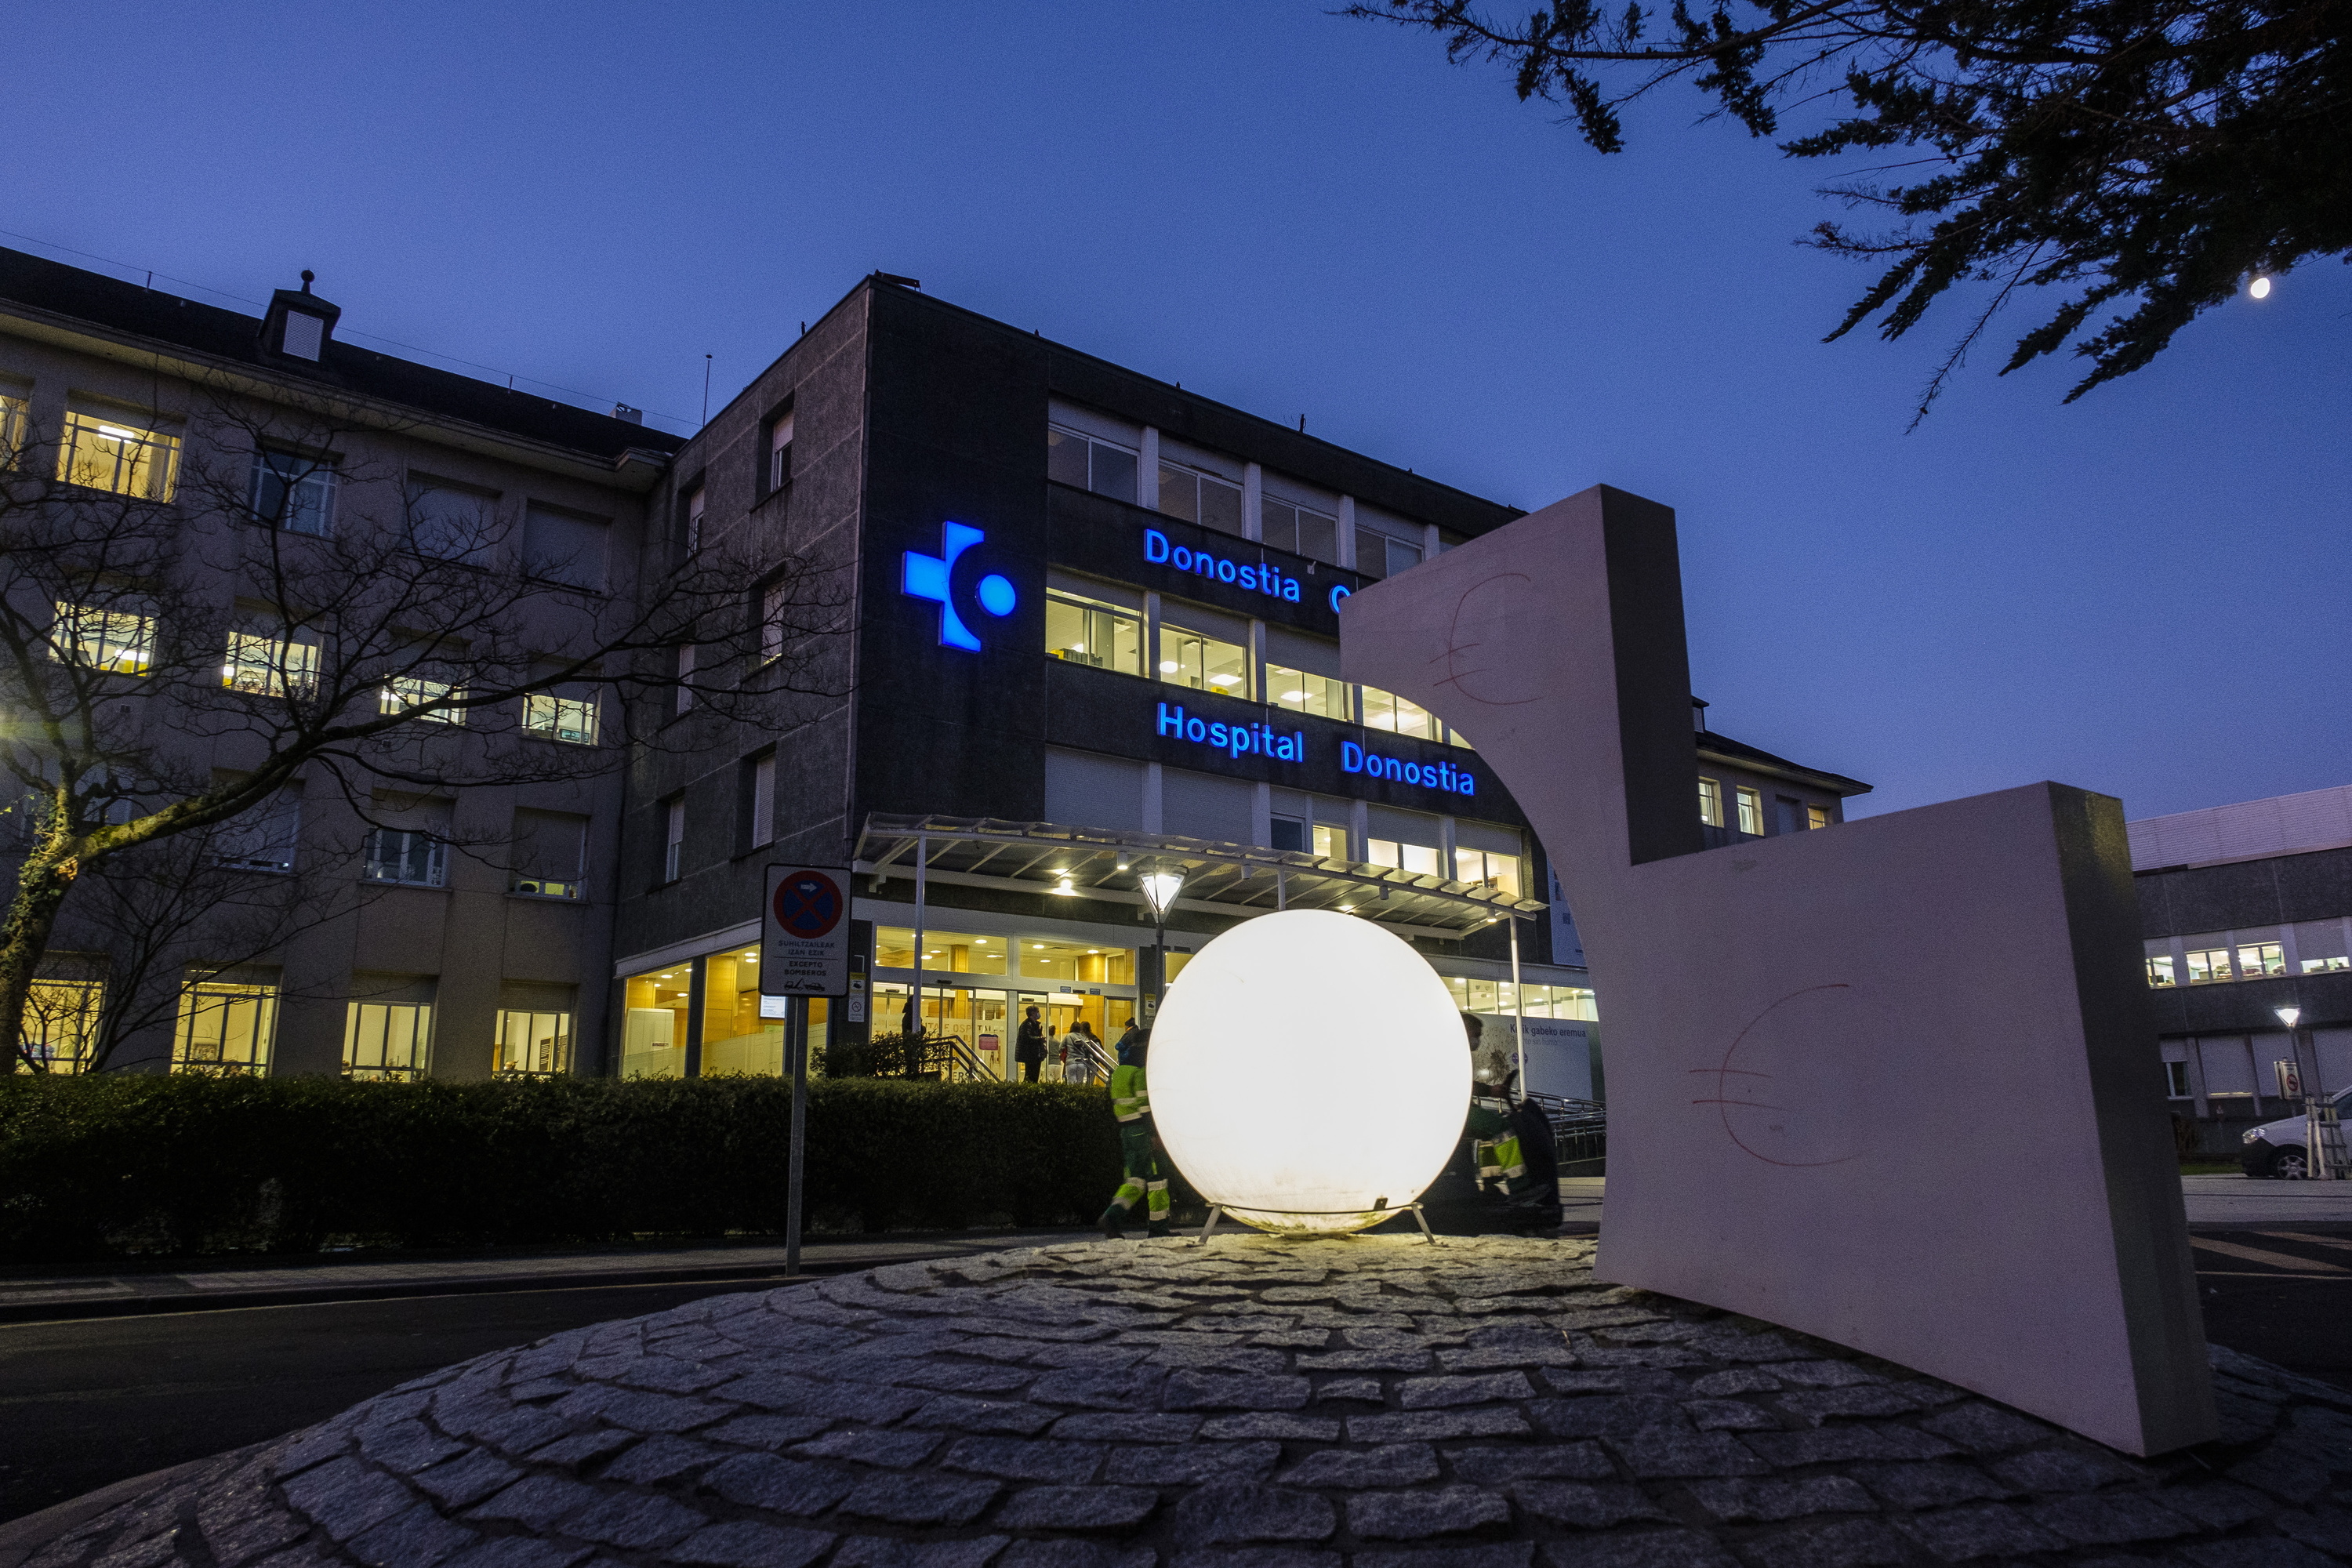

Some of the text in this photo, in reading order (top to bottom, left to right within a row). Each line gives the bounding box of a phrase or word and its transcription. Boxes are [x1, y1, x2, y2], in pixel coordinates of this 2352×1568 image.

[1145, 529, 1299, 602] Donostia
[1158, 702, 1474, 795] Hospital Donostia
[1531, 1025, 1558, 1036] gabeko
[1559, 1029, 1587, 1037] eremua
